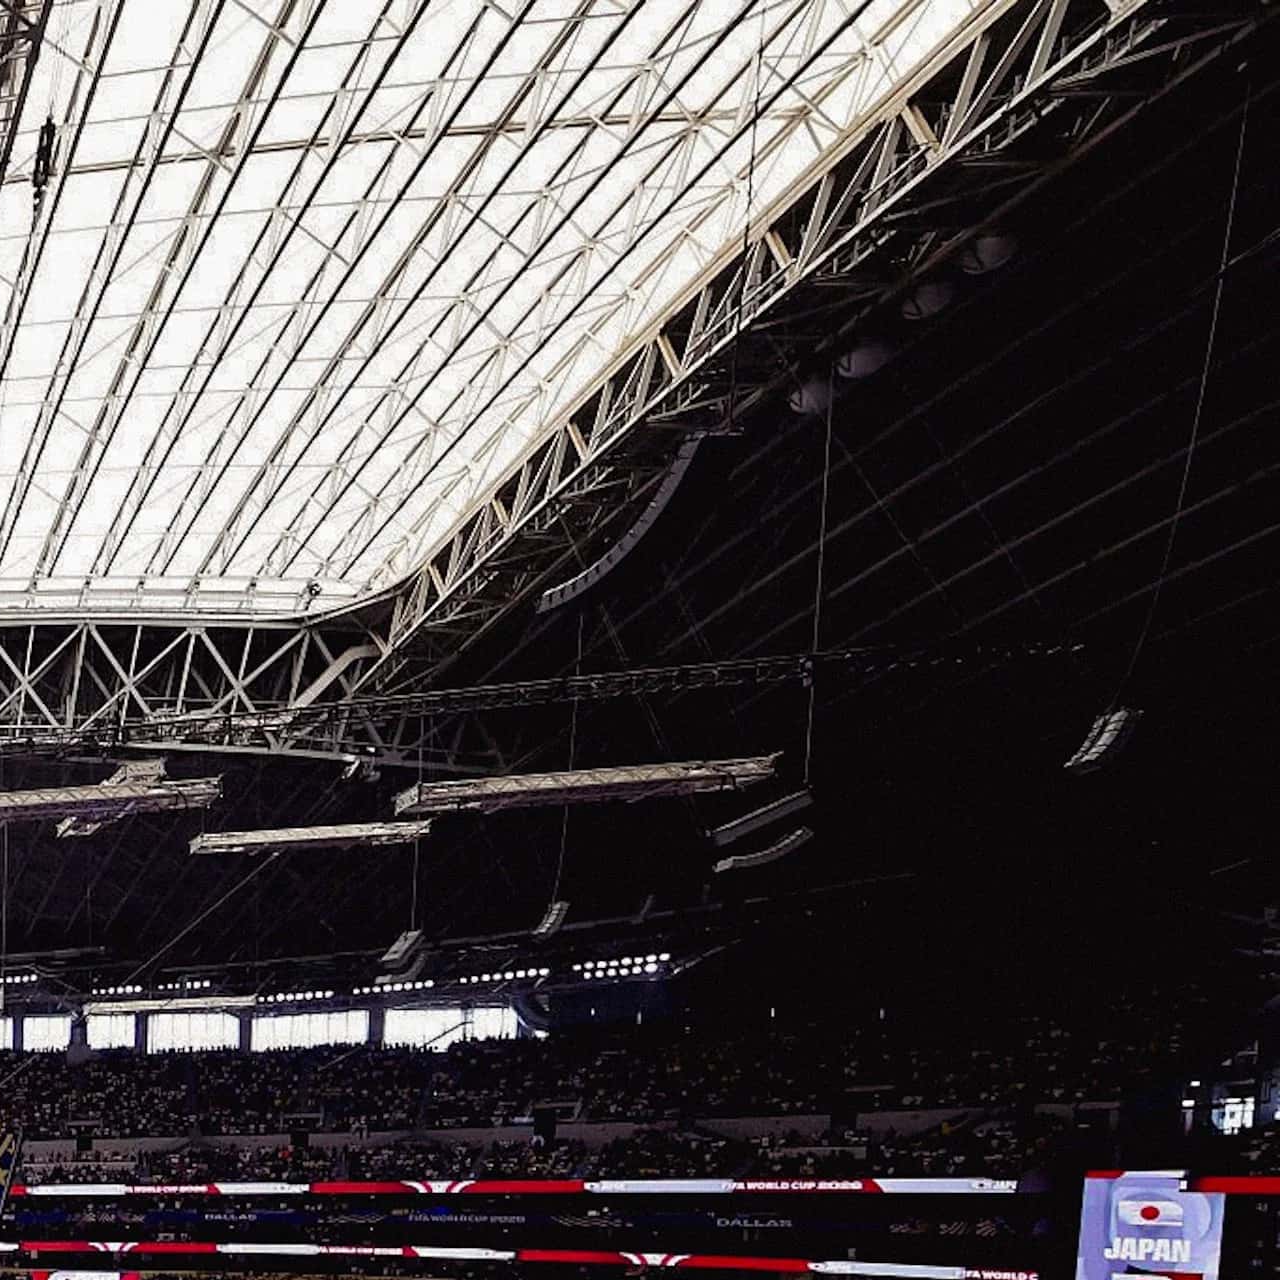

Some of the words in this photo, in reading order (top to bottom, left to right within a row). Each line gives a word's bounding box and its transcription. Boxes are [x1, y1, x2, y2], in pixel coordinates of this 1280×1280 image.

[747, 1181, 790, 1190] WORLD
[791, 1181, 816, 1190] CUP
[716, 1217, 792, 1228] DALLAS
[1104, 1237, 1190, 1263] JAPAN
[981, 1270, 1026, 1280] WORLD
